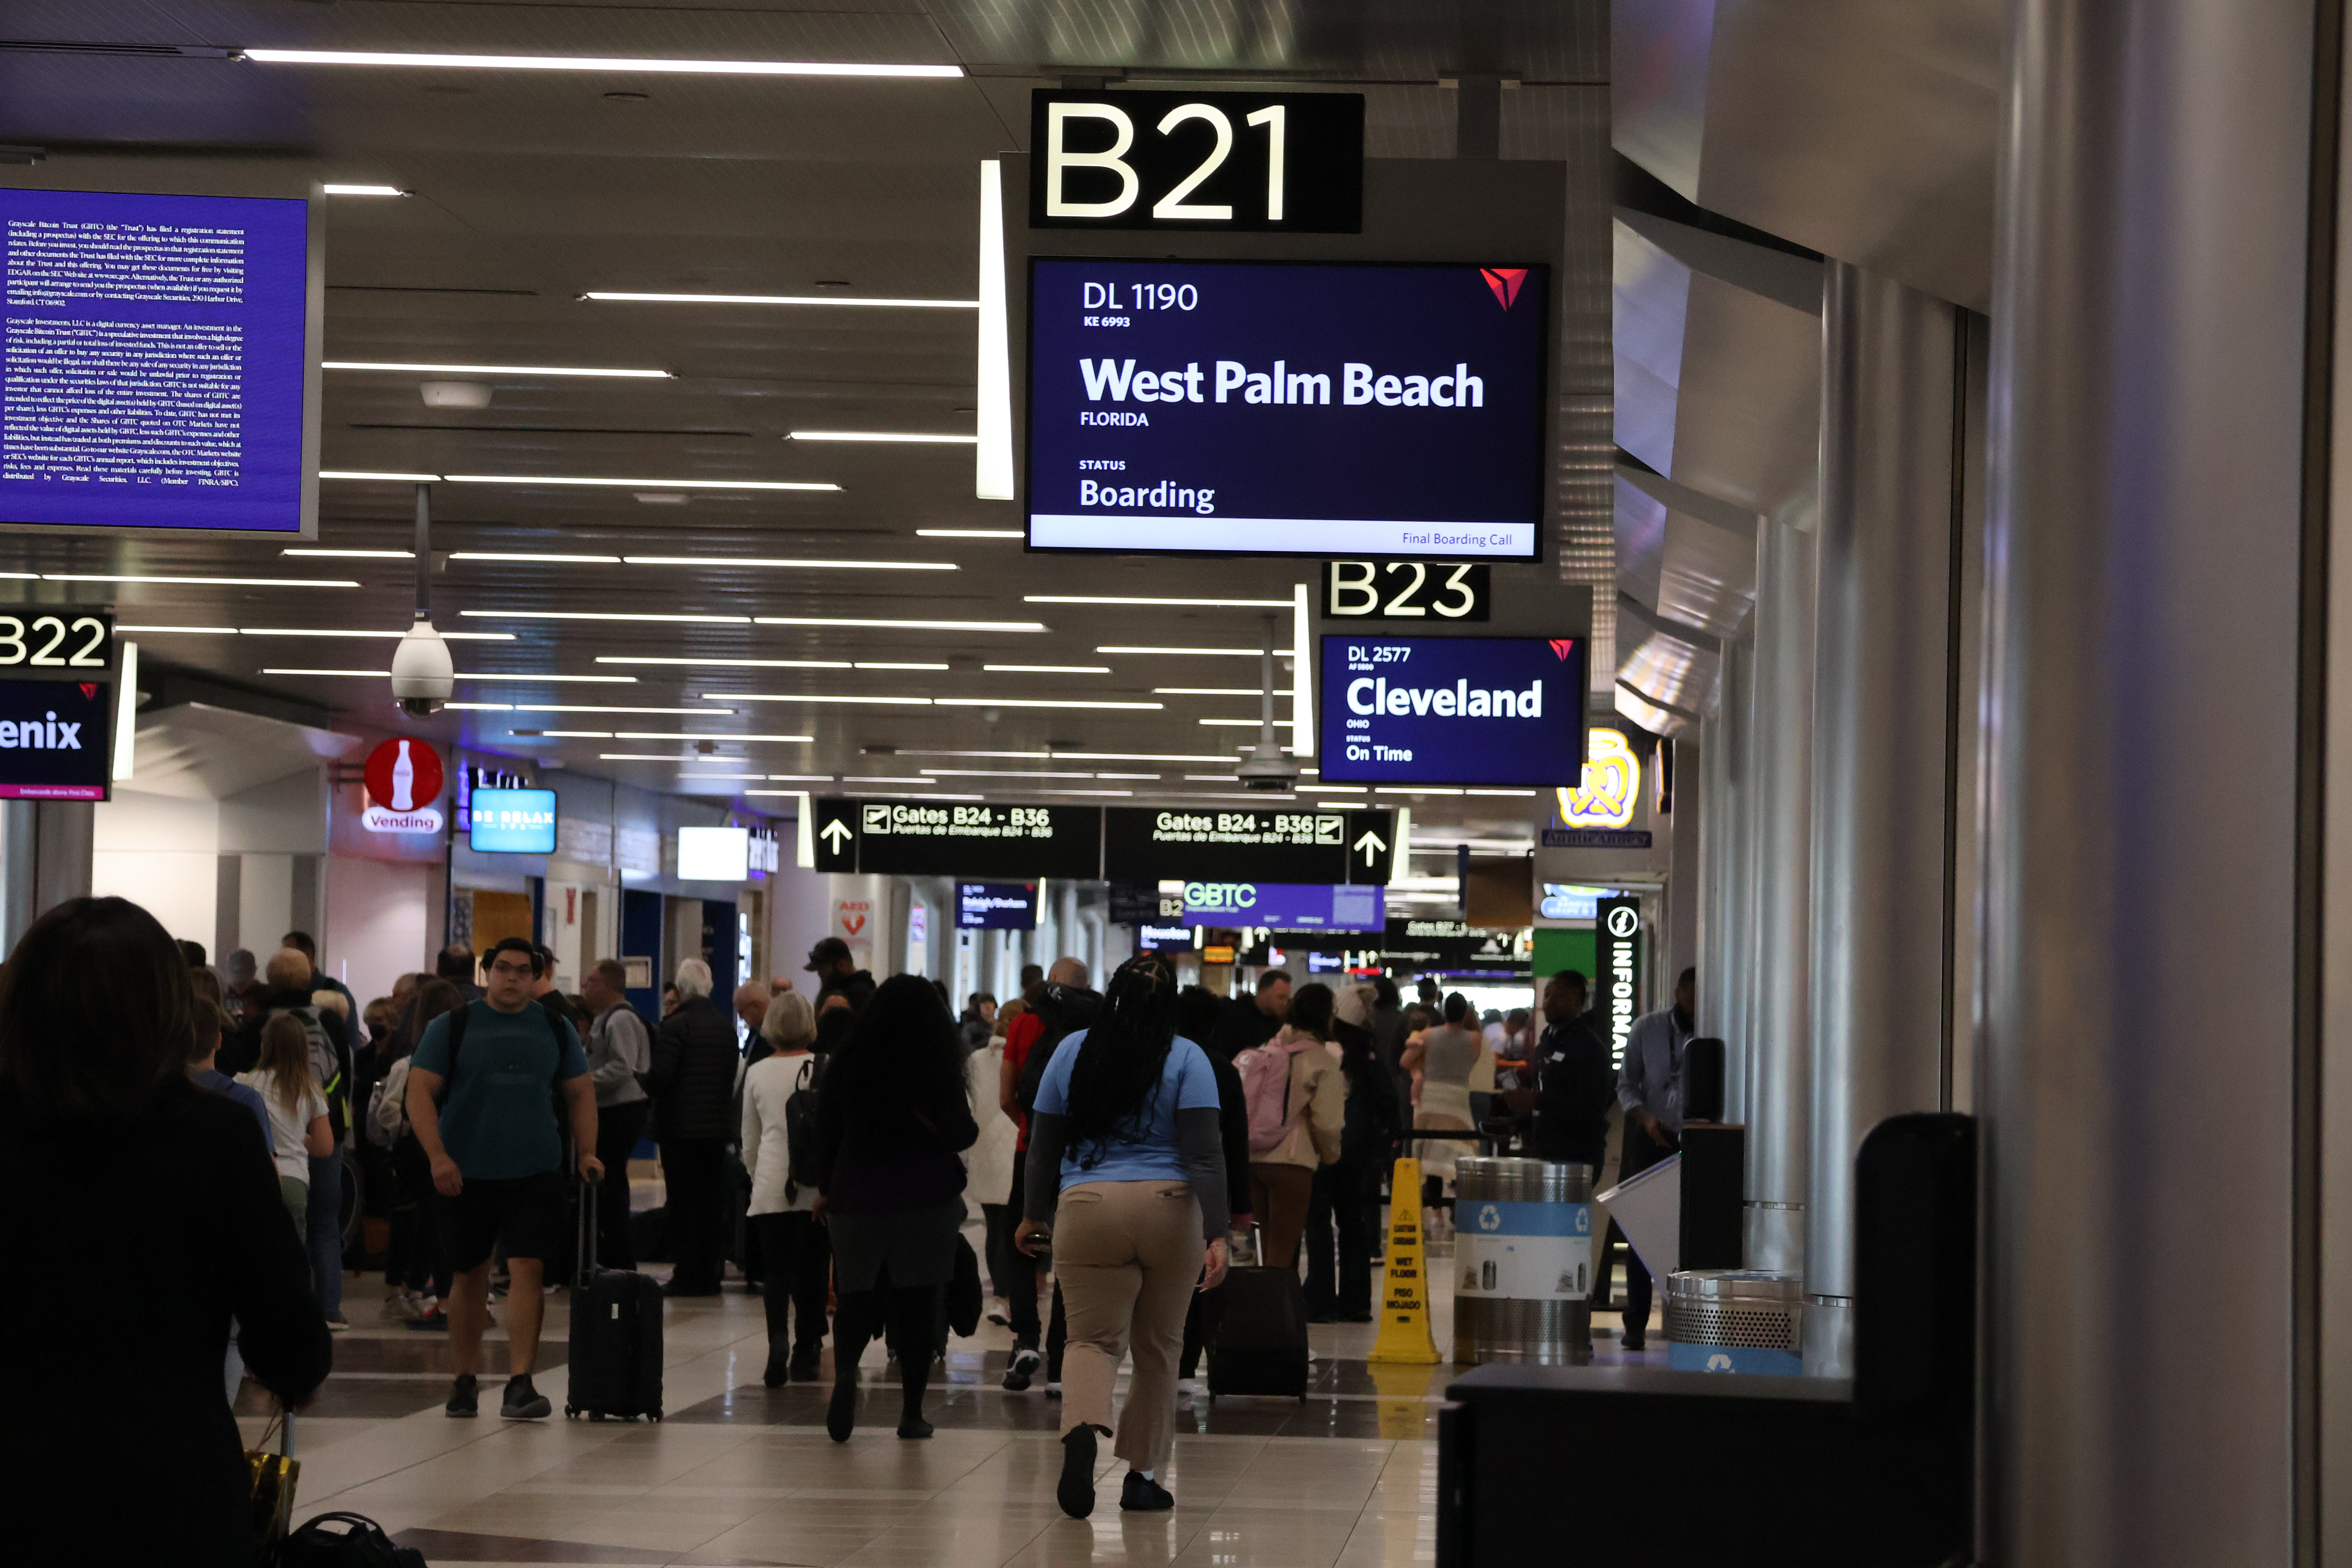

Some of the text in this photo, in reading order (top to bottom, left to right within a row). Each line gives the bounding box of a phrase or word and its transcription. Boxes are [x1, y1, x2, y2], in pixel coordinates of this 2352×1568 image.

[1047, 103, 1285, 220] B21
[1084, 283, 1197, 310] DL 1190
[1084, 316, 1130, 327] KE 6993
[1080, 359, 1483, 407] West Palm Beach
[1081, 412, 1149, 426] FLORIDA
[1080, 460, 1125, 470] STATUS
[1081, 480, 1214, 514] Boarding
[1403, 533, 1511, 547] Final Boarding Call
[1331, 562, 1474, 617] B23
[0, 616, 104, 666] B22
[1348, 646, 1411, 662] DL 2577
[1347, 677, 1542, 718] Cleveland
[1347, 719, 1369, 728] OHIO
[1347, 745, 1412, 761] On Time
[371, 815, 434, 831] Vending
[473, 810, 554, 824] BE RELAX
[893, 805, 948, 824] Gates
[953, 806, 991, 825] B24
[1011, 808, 1049, 826] B36
[1156, 812, 1212, 831] Gates
[1218, 813, 1256, 832] B24
[1275, 815, 1314, 833] B36
[893, 824, 931, 835] Puertas
[1152, 829, 1192, 841] Puertas
[1183, 882, 1257, 908] GBTC
[839, 901, 869, 911] AED
[1394, 1289, 1413, 1297] PISO
[1387, 1301, 1421, 1309] MOJADO
